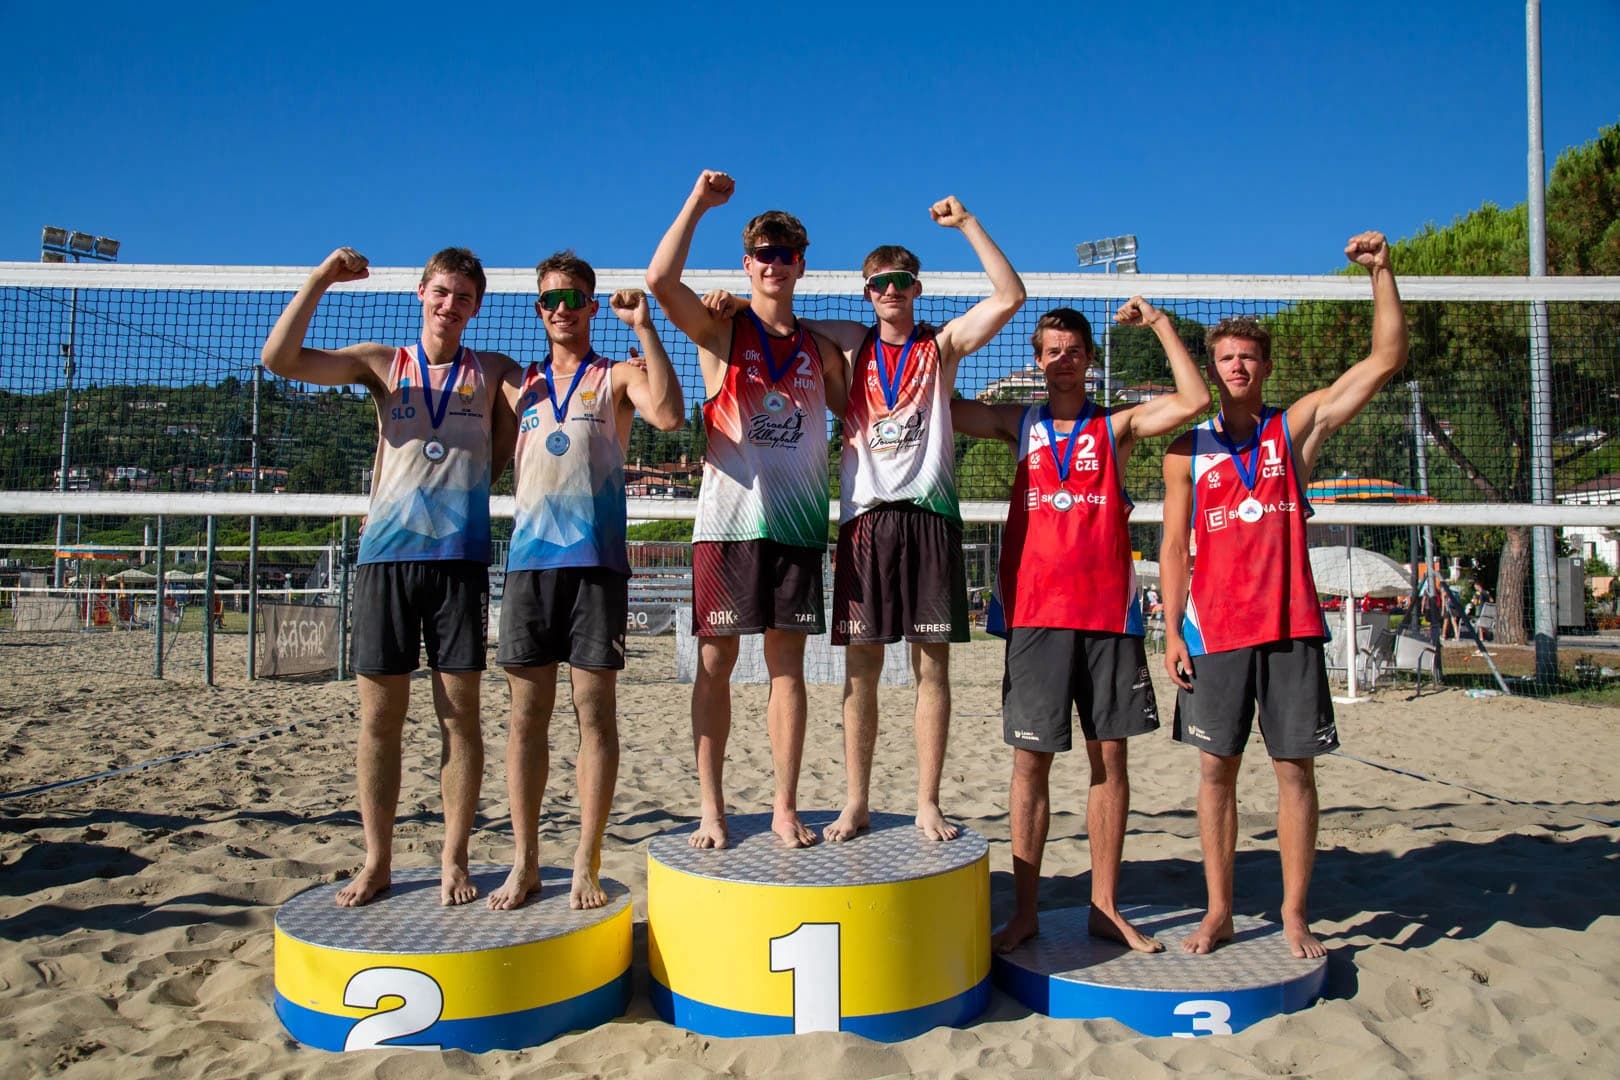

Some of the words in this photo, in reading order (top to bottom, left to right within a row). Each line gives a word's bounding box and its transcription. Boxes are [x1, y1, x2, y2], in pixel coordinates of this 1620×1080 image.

[796, 351, 813, 376] 2
[398, 377, 410, 405] 1
[794, 377, 816, 390] HUN
[392, 406, 416, 420] SLO
[523, 391, 538, 417] 2
[520, 416, 540, 433] SLO
[1077, 434, 1096, 459] 2
[1261, 439, 1281, 465] 1
[1075, 460, 1099, 471] CZE
[1262, 465, 1286, 478] CZE
[1087, 492, 1107, 505] ČEZ
[1278, 500, 1296, 512] ČEZ
[913, 624, 952, 632] VERESS
[769, 922, 841, 1031] 1
[343, 966, 444, 1051] 2
[1171, 999, 1233, 1038] 3
